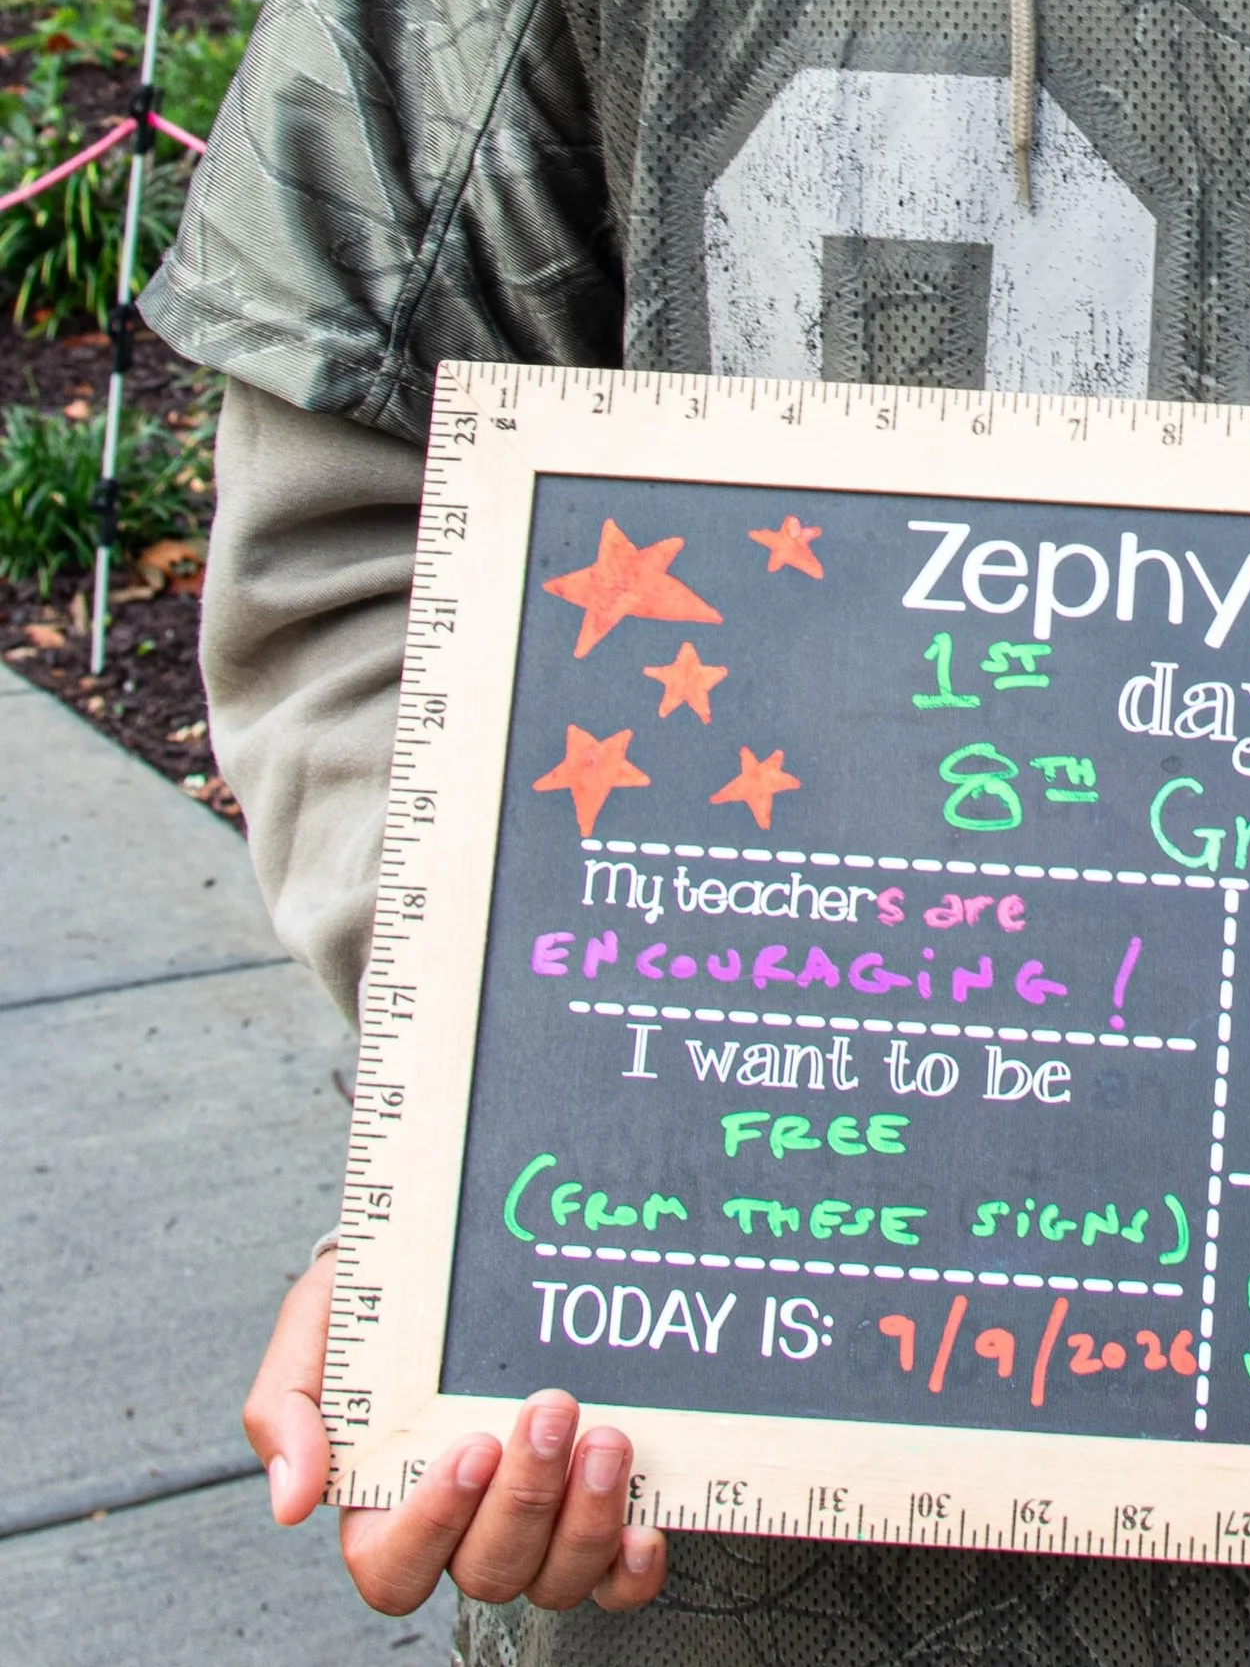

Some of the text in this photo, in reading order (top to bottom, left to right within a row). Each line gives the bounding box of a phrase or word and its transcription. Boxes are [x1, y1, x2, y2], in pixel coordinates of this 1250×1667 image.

[498, 388, 509, 409] 1
[591, 393, 604, 415] 2
[685, 399, 699, 420] 3
[781, 403, 796, 425] 4
[876, 409, 890, 430] 5
[971, 416, 986, 436] 6
[1068, 418, 1082, 441] 7
[1162, 424, 1176, 446] 8
[939, 743, 1098, 832] 8TH
[582, 859, 1026, 932] My teachers are
[346, 416, 478, 1427] 23 22 21 20 19 18 17 16 15 14 13
[622, 1023, 1071, 1103] I want to be
[721, 1112, 910, 1159] FREE
[722, 1196, 927, 1246] THESE
[532, 1281, 1198, 1407] TODAY IS: 9/9/2026
[715, 1480, 748, 1506] 32
[818, 1486, 849, 1512] 31
[917, 1492, 951, 1518] 30
[1020, 1498, 1052, 1525] 29
[1121, 1504, 1155, 1531] 28
